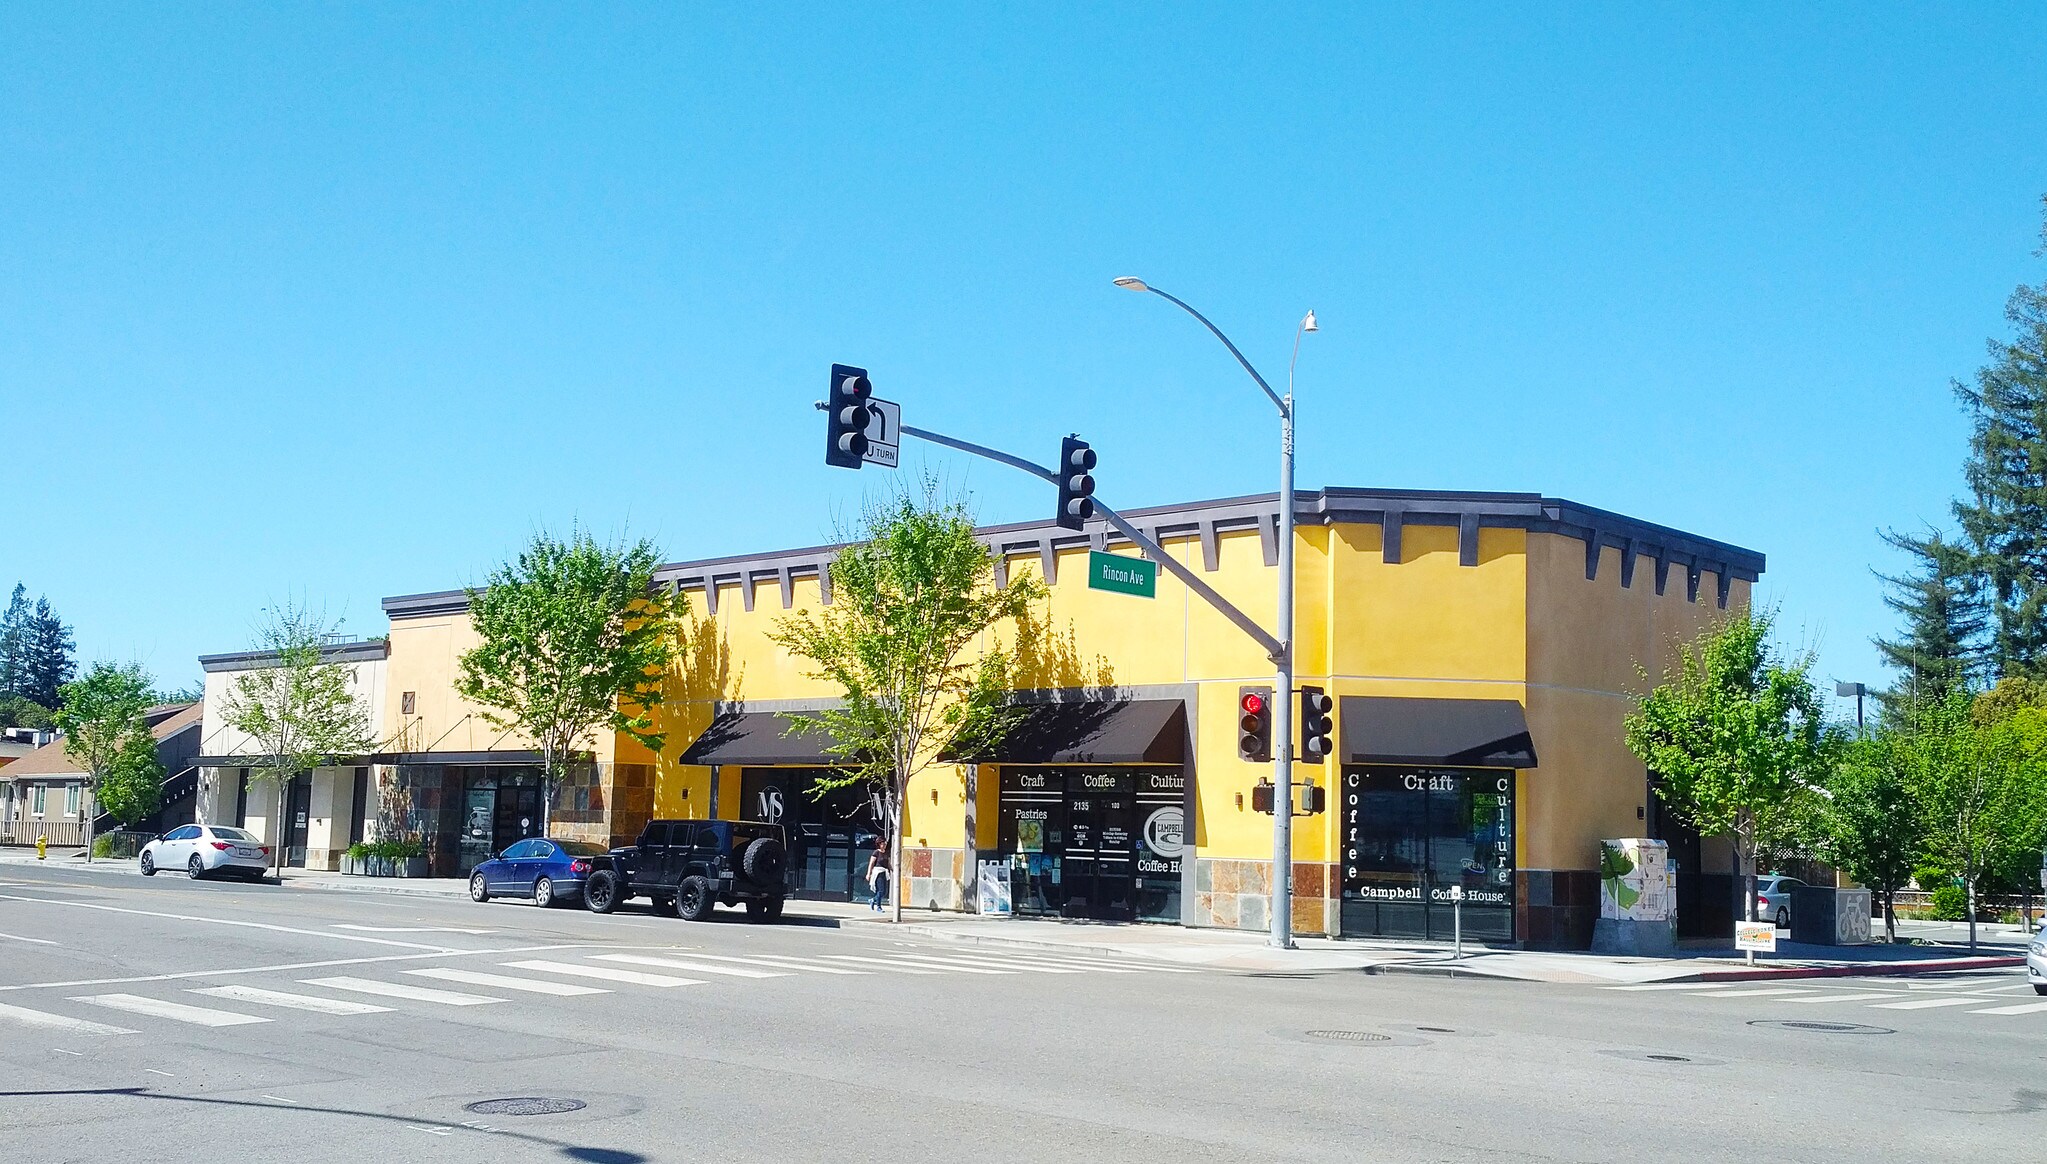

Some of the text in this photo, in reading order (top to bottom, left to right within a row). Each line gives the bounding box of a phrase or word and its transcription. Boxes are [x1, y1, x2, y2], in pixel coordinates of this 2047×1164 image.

[866, 445, 895, 460] U TURN
[1103, 564, 1144, 586] Rincon Ave
[1020, 774, 1045, 787] Craft
[1084, 773, 1115, 788] Coffee
[1404, 774, 1454, 791] Craft
[1074, 801, 1089, 811] 2135
[1015, 808, 1047, 820] Pastries
[1157, 823, 1184, 833] CAMPBELL
[1348, 774, 1359, 878] Coffee
[1496, 778, 1508, 882] Culture
[1138, 859, 1169, 873] Coffee
[1462, 860, 1483, 870] OPEN
[1361, 886, 1421, 900] Campbell
[1431, 888, 1466, 901] Cofe
[1468, 890, 1504, 902] House
